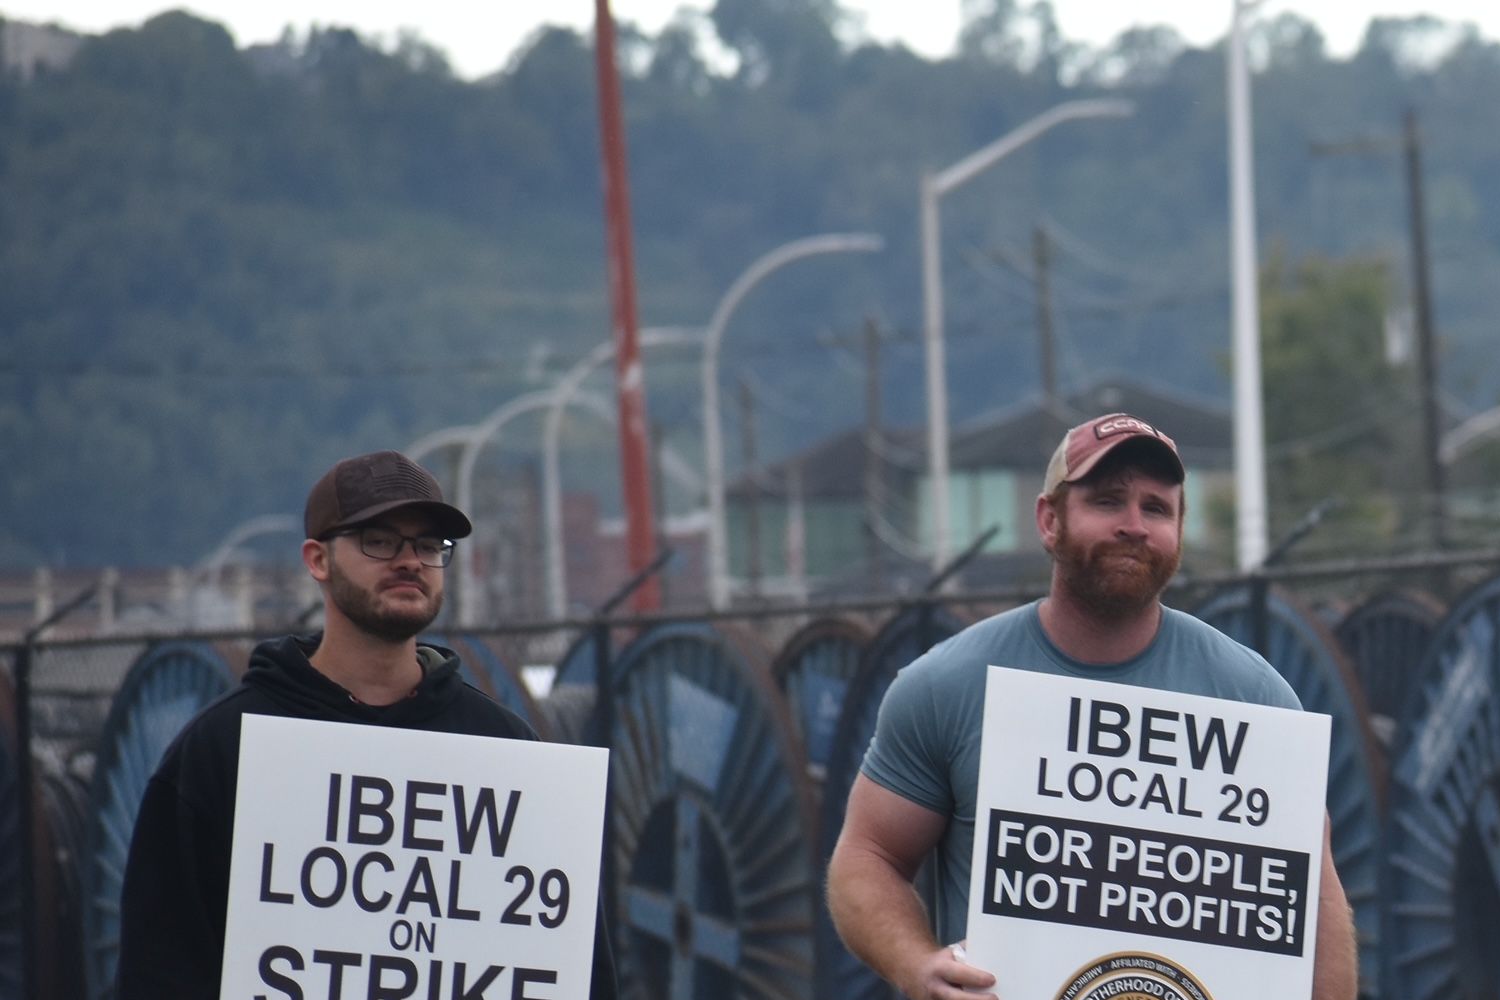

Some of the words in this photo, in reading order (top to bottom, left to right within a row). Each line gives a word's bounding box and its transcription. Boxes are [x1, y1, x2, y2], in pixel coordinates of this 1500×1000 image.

[1067, 696, 1250, 776] IBEW
[325, 772, 522, 858] IBEW
[1037, 757, 1203, 819] LOCAL
[1217, 783, 1270, 827] 29
[259, 842, 481, 922] LOCAL
[500, 865, 570, 929] 29
[997, 820, 1093, 869] FOR
[1108, 835, 1298, 905] PEOPLE,
[389, 919, 437, 954] ON
[993, 867, 1088, 914] NOT
[1099, 881, 1298, 944] PROFITS!
[1066, 965, 1103, 997] AMERICAN
[1110, 958, 1156, 970] AFFILIATED
